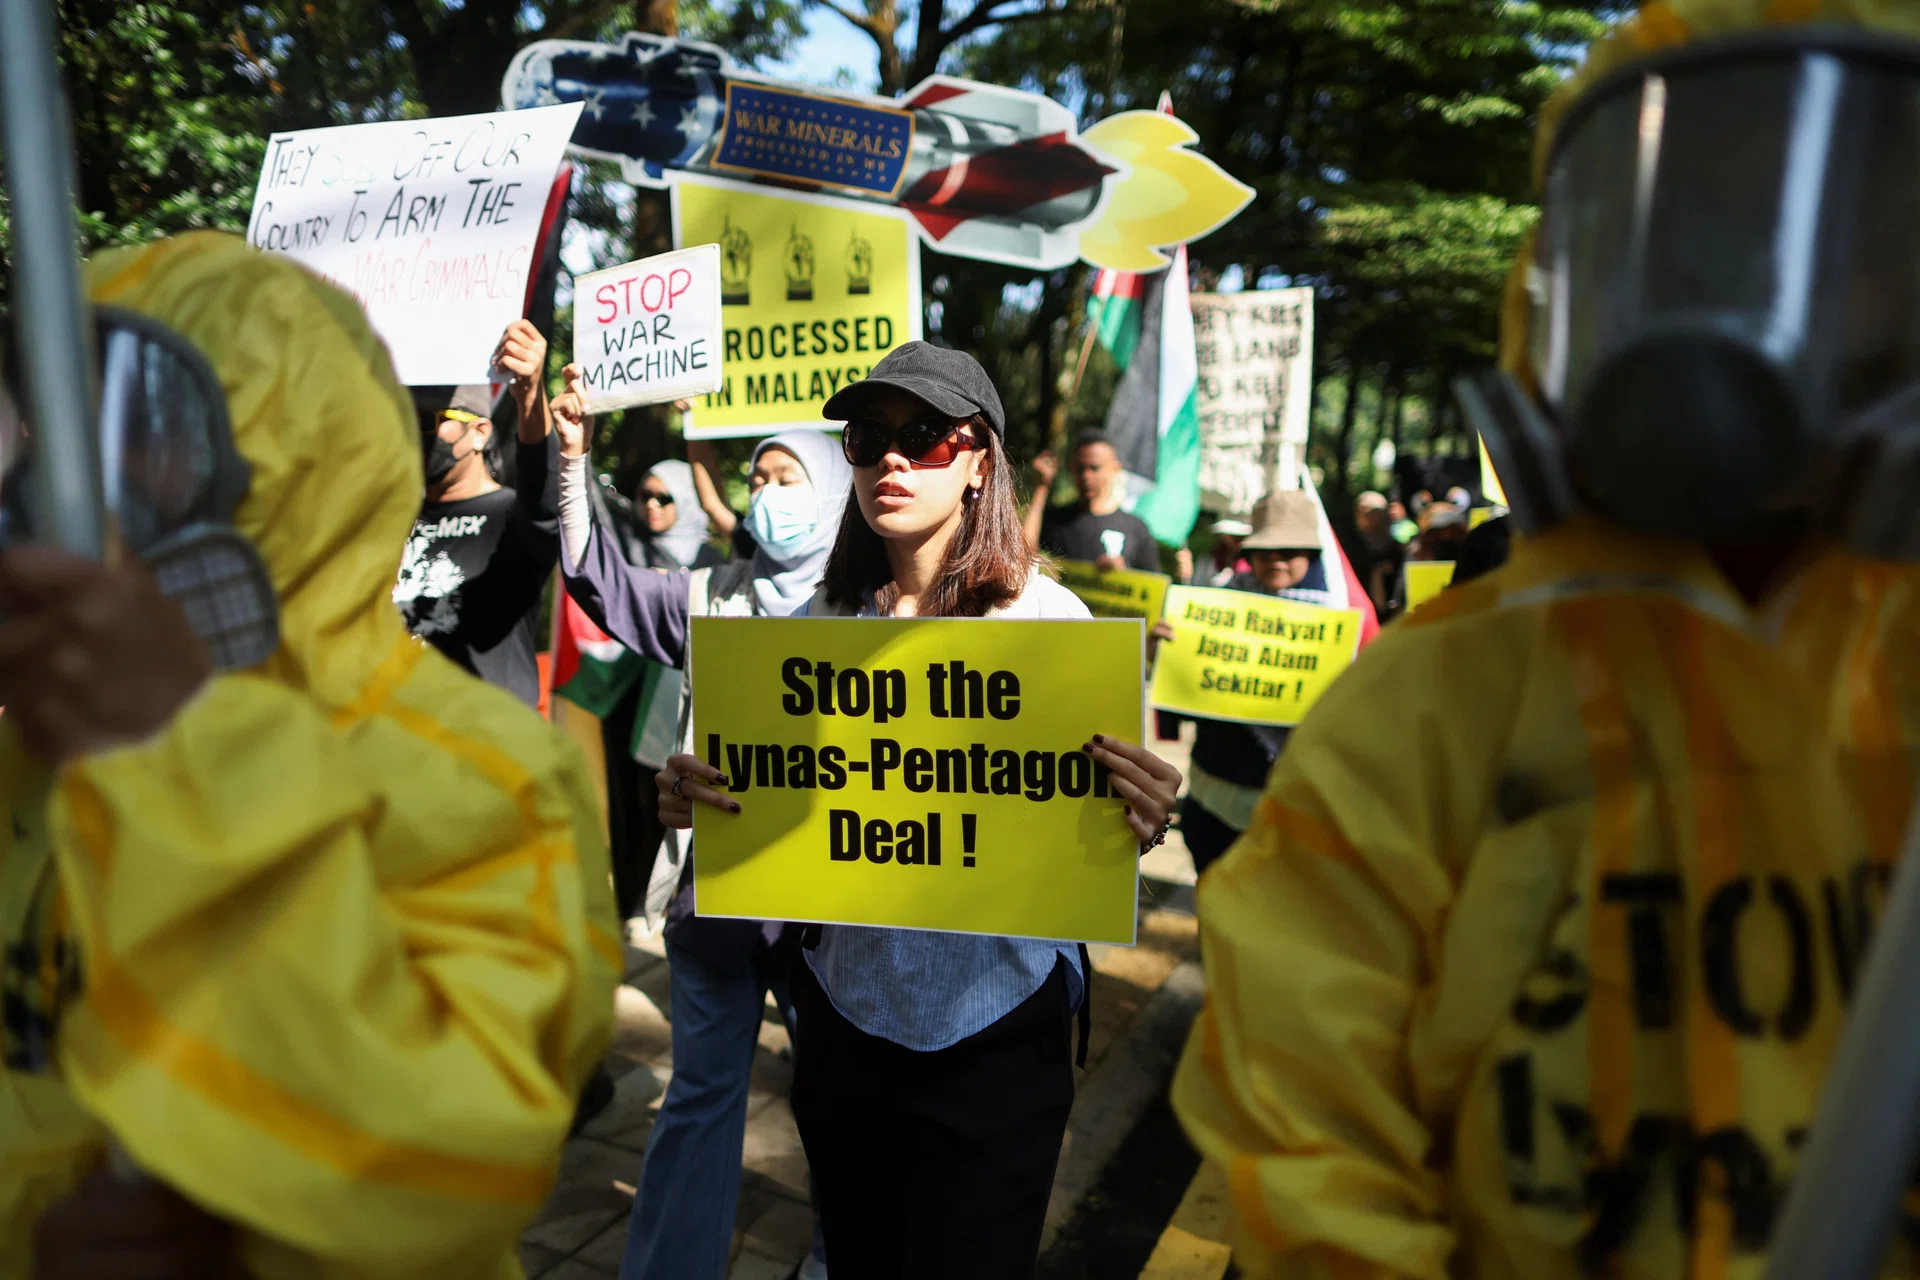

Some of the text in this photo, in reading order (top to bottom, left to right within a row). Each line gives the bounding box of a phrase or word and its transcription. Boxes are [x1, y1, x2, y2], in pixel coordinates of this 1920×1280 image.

[735, 110, 903, 159] WAR MINERALS
[269, 137, 321, 188] THEY
[253, 202, 335, 250] COUNTRY
[376, 187, 448, 239] ARM
[463, 177, 523, 228] THE
[408, 238, 529, 302] CRIMINALS
[596, 268, 692, 323] STOP
[603, 313, 676, 356] WAR
[724, 316, 893, 363] ROCESSED
[582, 338, 709, 391] MACHINE
[1184, 599, 1236, 629] Jaga
[1244, 610, 1325, 642] Rakyat
[1196, 634, 1319, 672] Jaga Alam
[781, 657, 1021, 723] Stop the
[1200, 667, 1288, 699] Sekitar
[829, 809, 977, 868] Deal !
